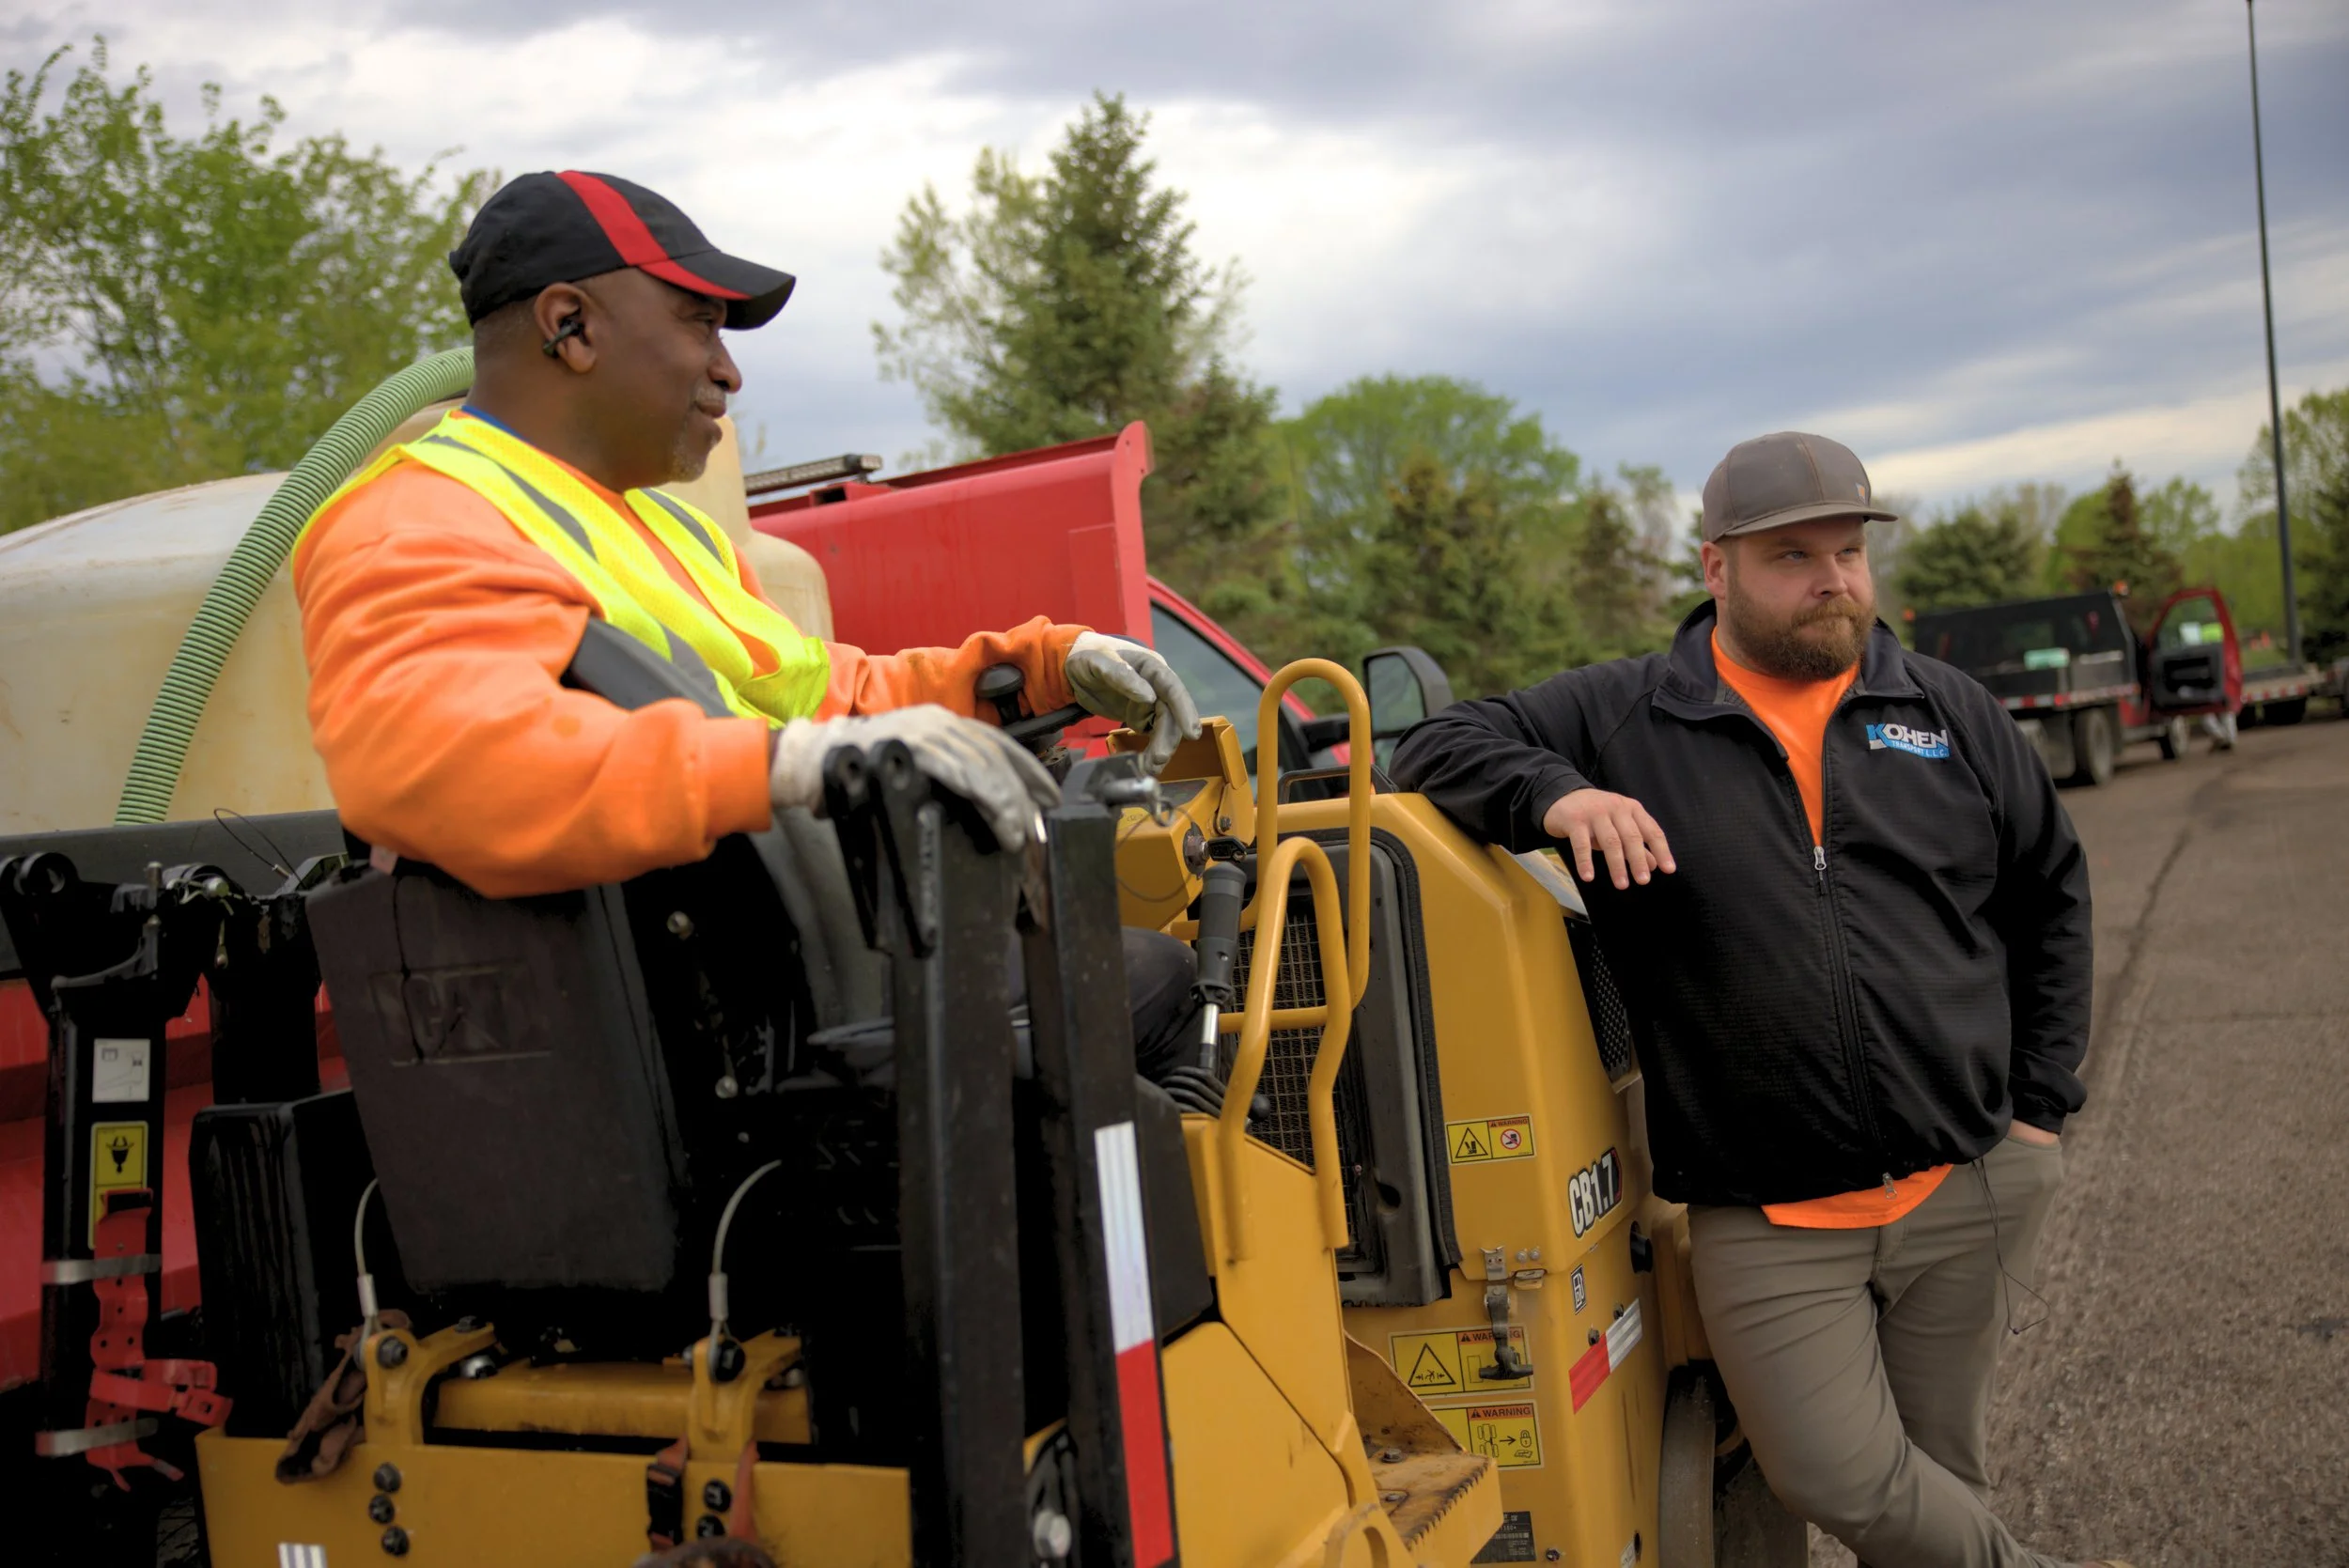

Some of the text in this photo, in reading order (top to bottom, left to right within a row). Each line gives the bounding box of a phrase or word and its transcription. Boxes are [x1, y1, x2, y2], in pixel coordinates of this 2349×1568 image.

[1865, 723, 1949, 750] KOHEN
[1891, 740, 1924, 756] TRANSPORT
[1498, 1118, 1528, 1127] WARNING
[1569, 1152, 1615, 1235] CB1.7
[1482, 1406, 1531, 1418] WARNING
